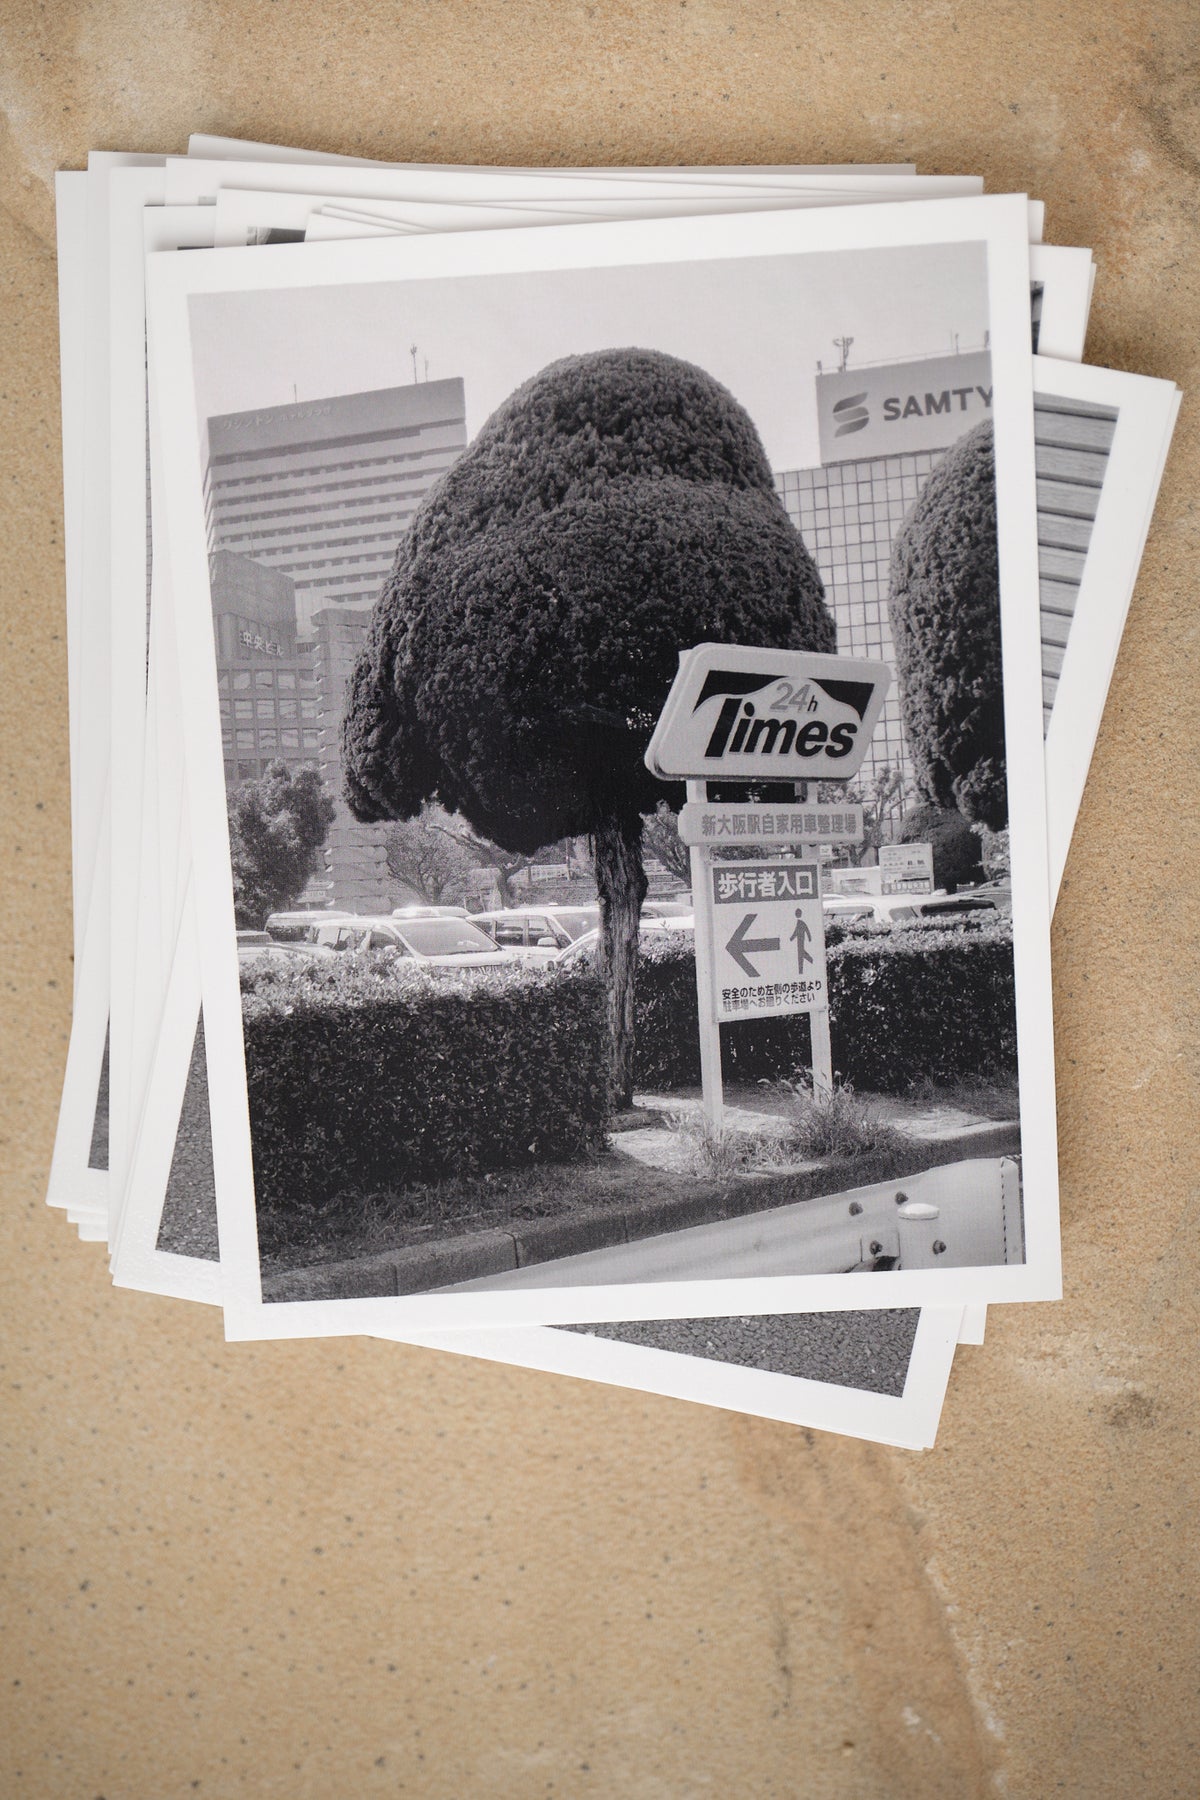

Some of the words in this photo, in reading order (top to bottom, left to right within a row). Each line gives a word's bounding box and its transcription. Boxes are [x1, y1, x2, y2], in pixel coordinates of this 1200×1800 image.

[883, 386, 993, 421] SAMTY
[704, 697, 858, 758] Times
[701, 813, 857, 836] 新大阪駅自家用車整理場
[718, 870, 813, 900] 歩行者入口
[721, 980, 822, 1000] 安全のため左側の歩道より
